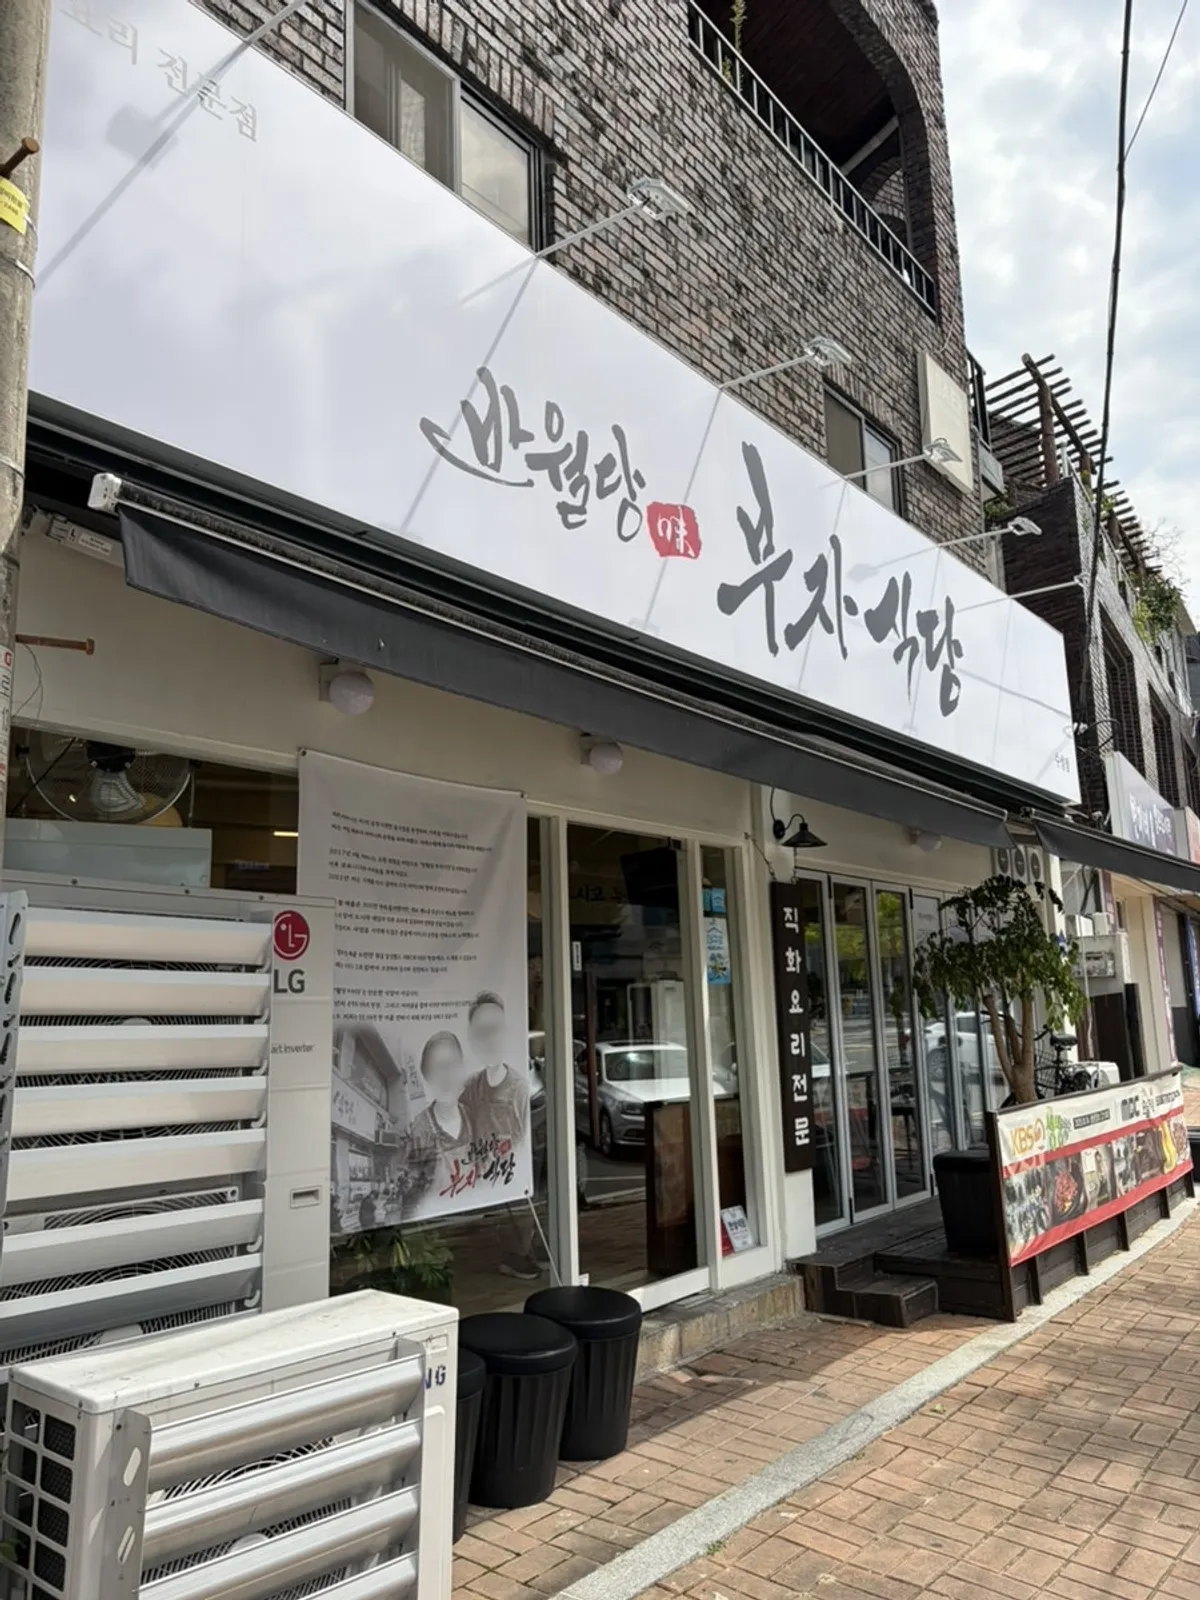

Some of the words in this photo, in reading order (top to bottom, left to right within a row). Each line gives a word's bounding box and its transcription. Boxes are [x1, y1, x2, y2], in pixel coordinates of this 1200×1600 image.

[157, 47, 258, 143] 전문점
[420, 366, 647, 543] 반월당
[717, 441, 964, 717] 부자식당
[274, 969, 305, 994] LG
